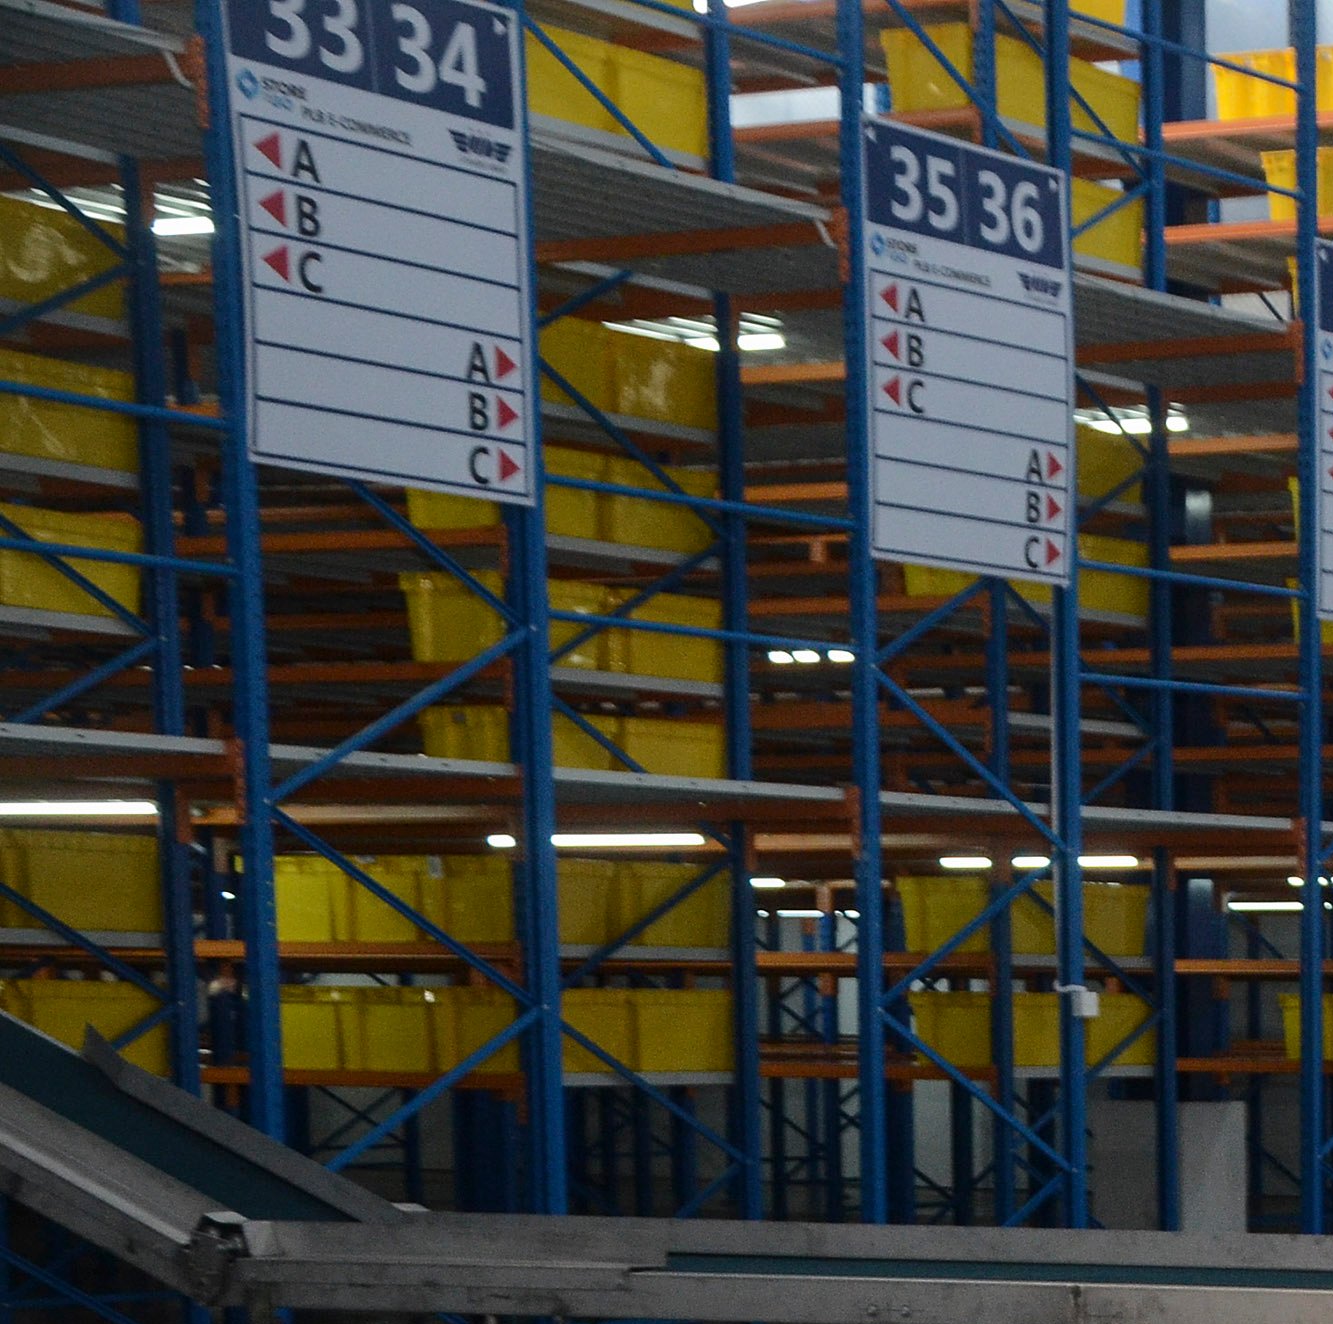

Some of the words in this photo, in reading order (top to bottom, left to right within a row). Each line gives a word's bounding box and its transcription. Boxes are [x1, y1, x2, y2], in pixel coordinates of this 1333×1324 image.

[264, 0, 364, 74] 33
[391, 3, 487, 108] 34
[291, 139, 320, 184] A
[298, 196, 319, 238] B
[890, 144, 960, 231] 35
[977, 169, 1044, 253] 36
[299, 253, 323, 294] C
[904, 287, 924, 323] A
[465, 342, 491, 384] A
[906, 335, 924, 368] B
[470, 393, 488, 431] B
[906, 380, 925, 414] C
[469, 446, 489, 484] C
[1026, 449, 1043, 484] A
[1026, 492, 1041, 525] B
[1024, 536, 1040, 570] C
